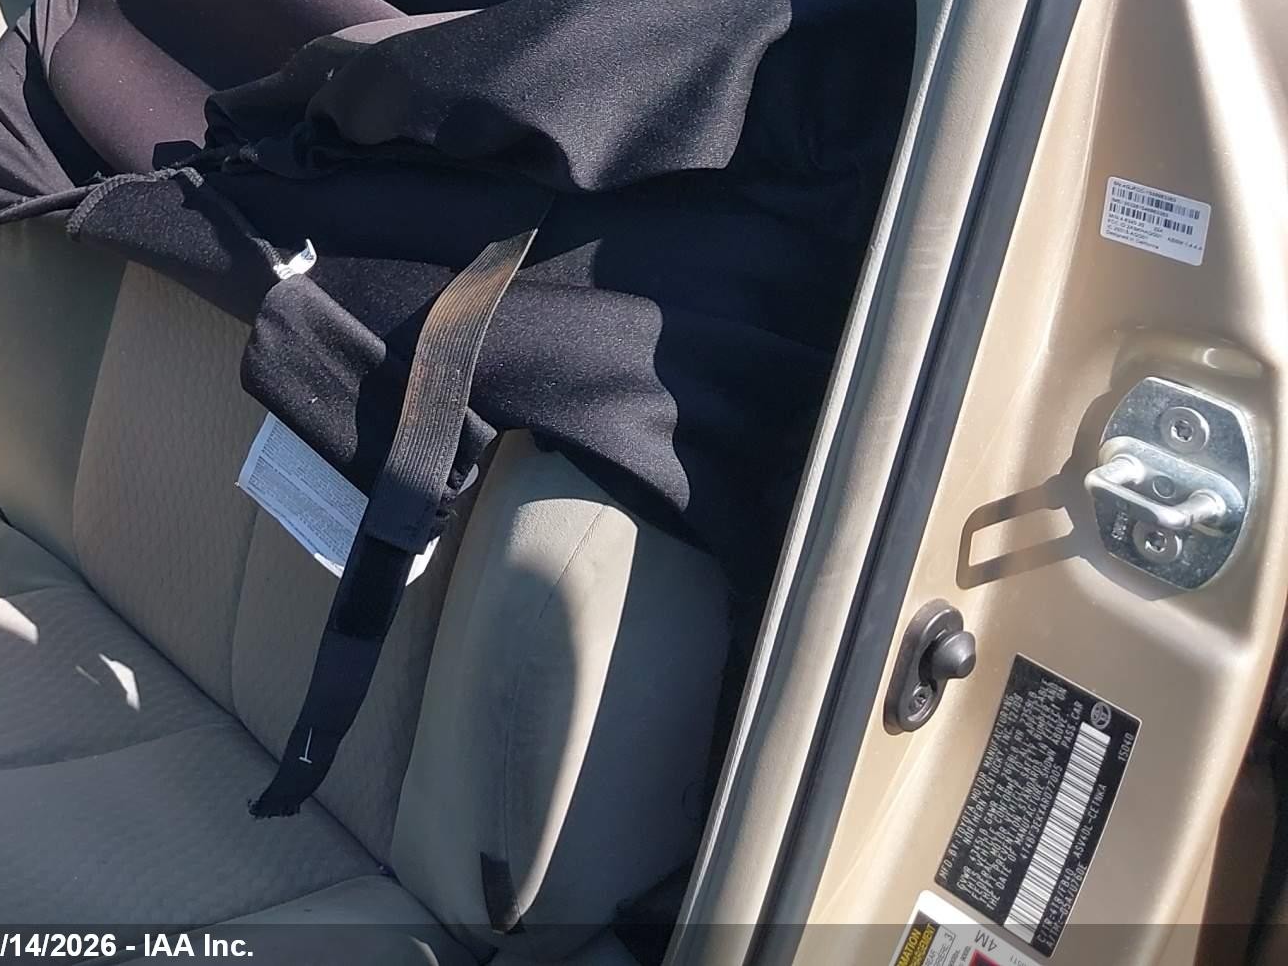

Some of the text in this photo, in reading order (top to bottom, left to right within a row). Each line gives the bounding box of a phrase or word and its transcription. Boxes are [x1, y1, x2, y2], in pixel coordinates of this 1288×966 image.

[969, 769, 987, 802] MOTOR
[1116, 731, 1134, 763] 15040
[955, 864, 972, 891] GVWR
[982, 798, 999, 825] GAWR
[961, 797, 987, 846] NORTHERN
[963, 868, 981, 895] THIS
[974, 825, 999, 869] VEHICLE
[993, 775, 1018, 824] CONFORMS
[970, 857, 994, 901] FEDERAL
[988, 824, 1008, 857] MOTOR
[1002, 780, 1025, 824] VEHICLE
[978, 873, 997, 906] THEFT
[992, 812, 1022, 873] PREVENTION
[1016, 757, 1043, 812] STANDARDS
[1041, 703, 1061, 740] EFFECT
[985, 709, 1070, 911] THE DATE OF MANUFACTURE SHOWN ABOVE.
[974, 929, 998, 952] 4M
